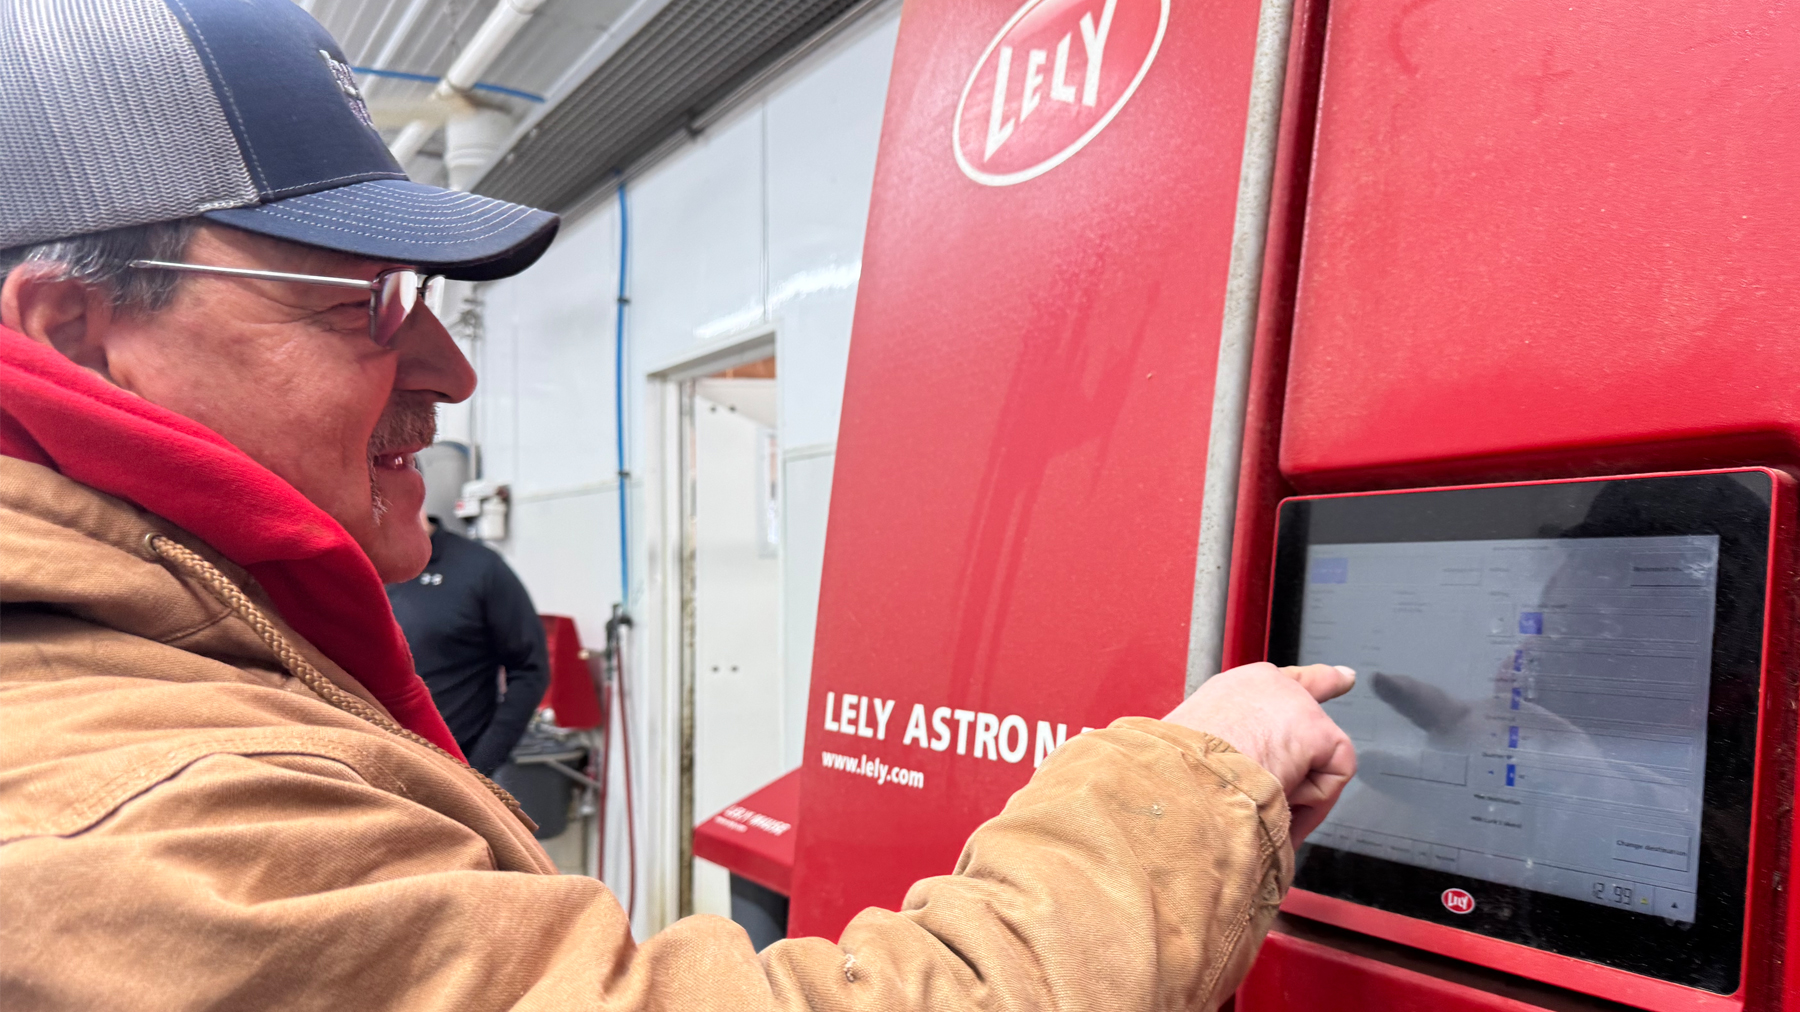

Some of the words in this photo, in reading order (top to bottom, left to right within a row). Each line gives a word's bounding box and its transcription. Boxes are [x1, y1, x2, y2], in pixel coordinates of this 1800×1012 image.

[983, 0, 1118, 163] LELY
[824, 691, 896, 741] LELY
[902, 703, 1096, 769] ASTRON
[822, 751, 925, 789] www.lely.com
